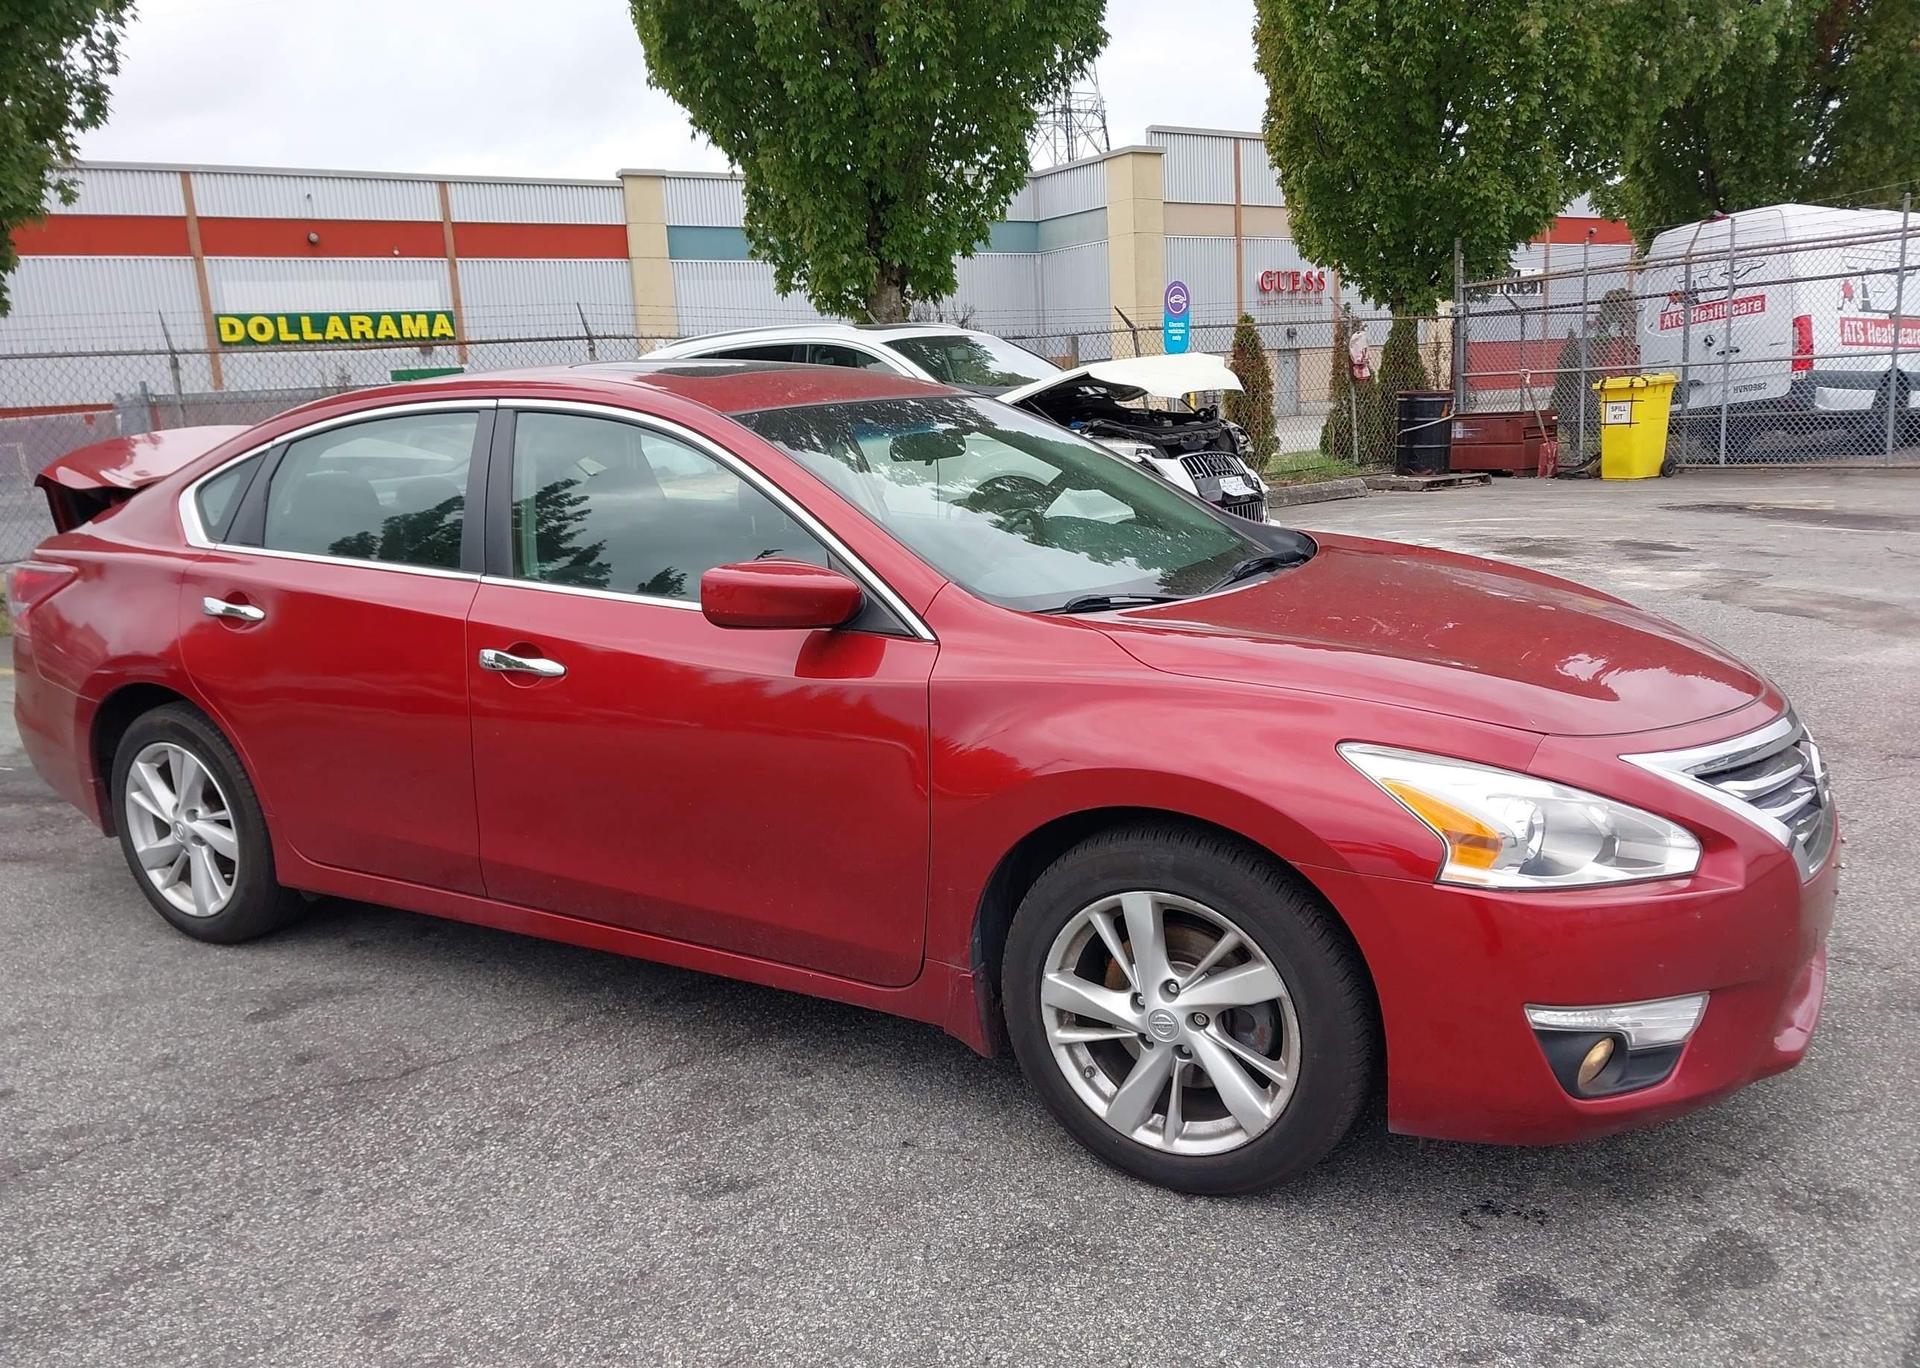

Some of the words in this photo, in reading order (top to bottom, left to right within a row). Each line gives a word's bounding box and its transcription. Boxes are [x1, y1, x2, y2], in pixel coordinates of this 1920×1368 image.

[1259, 270, 1327, 292] GUESS
[218, 314, 454, 343] DOLLARAMA
[1663, 310, 1685, 329] ATS
[1843, 320, 1865, 344] ATS
[1613, 413, 1624, 421] KIT
